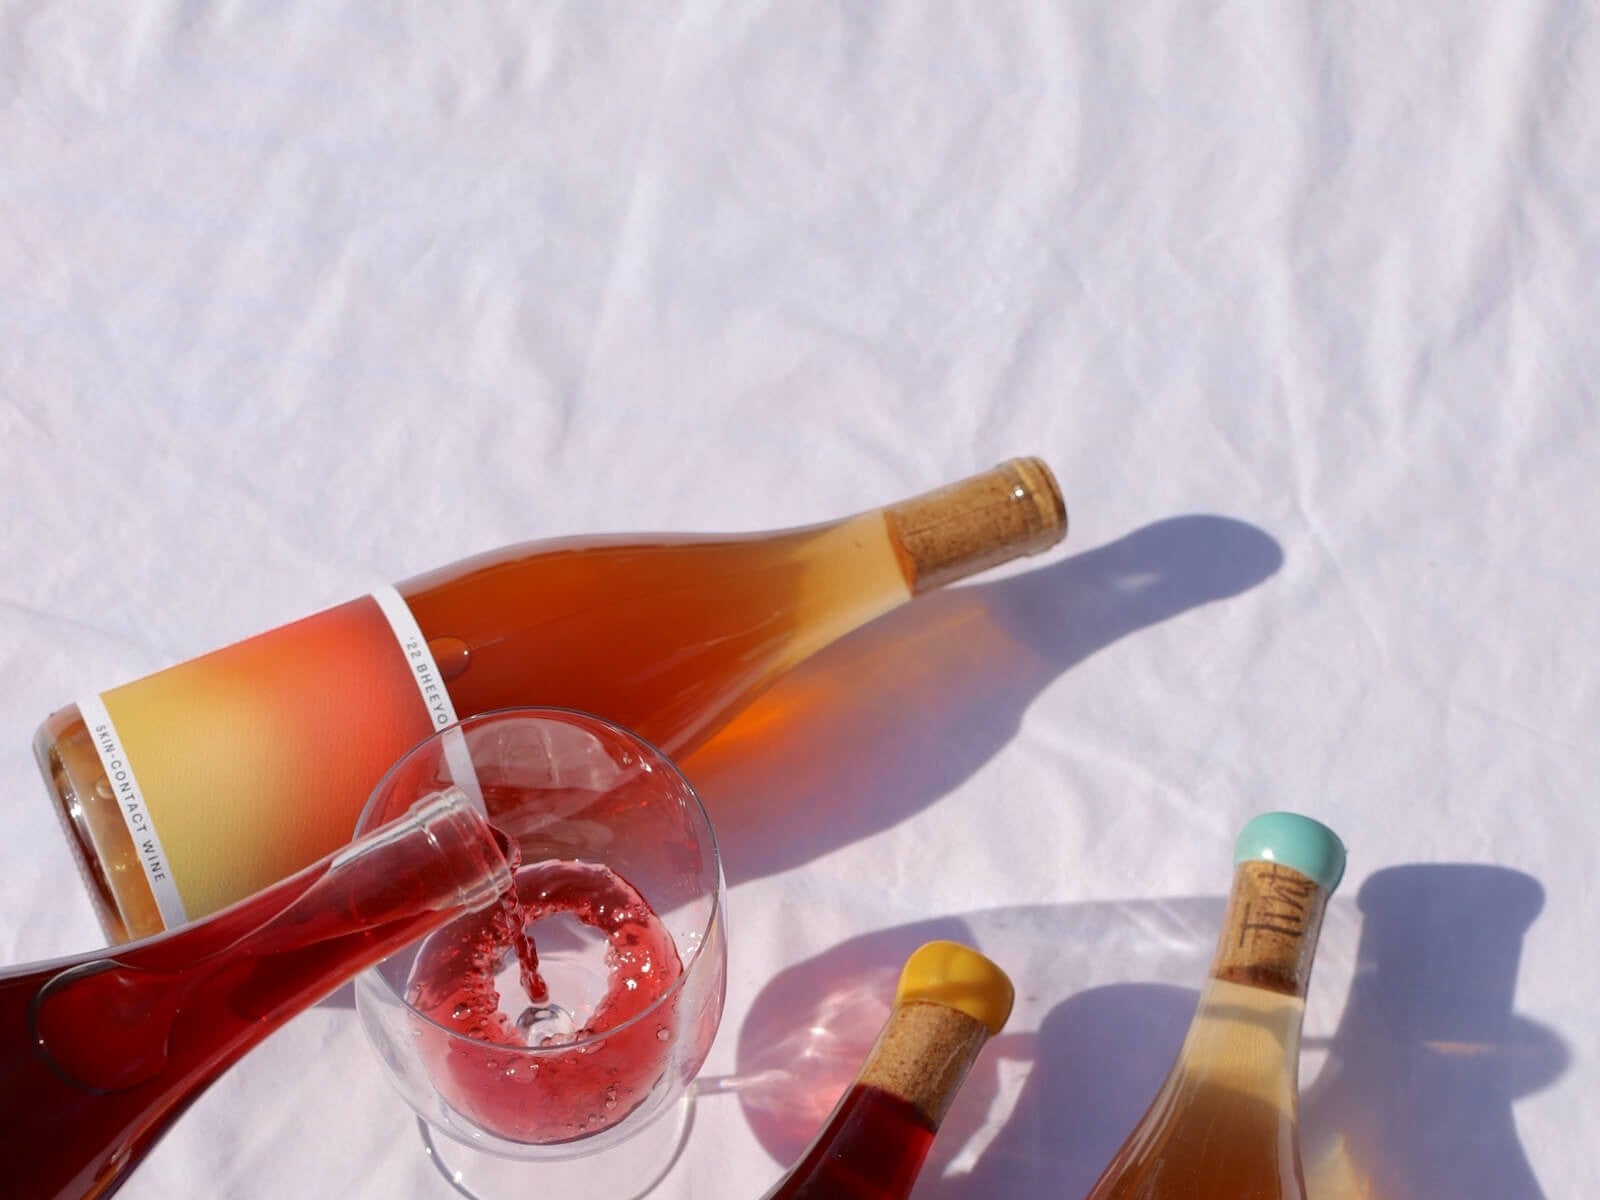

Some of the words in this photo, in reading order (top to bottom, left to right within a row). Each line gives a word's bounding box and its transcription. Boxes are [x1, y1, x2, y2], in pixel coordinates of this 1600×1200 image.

[416, 663, 449, 725] BHEEYO
[95, 724, 147, 833] SKIN-CONTACT
[142, 839, 166, 883] WINE
